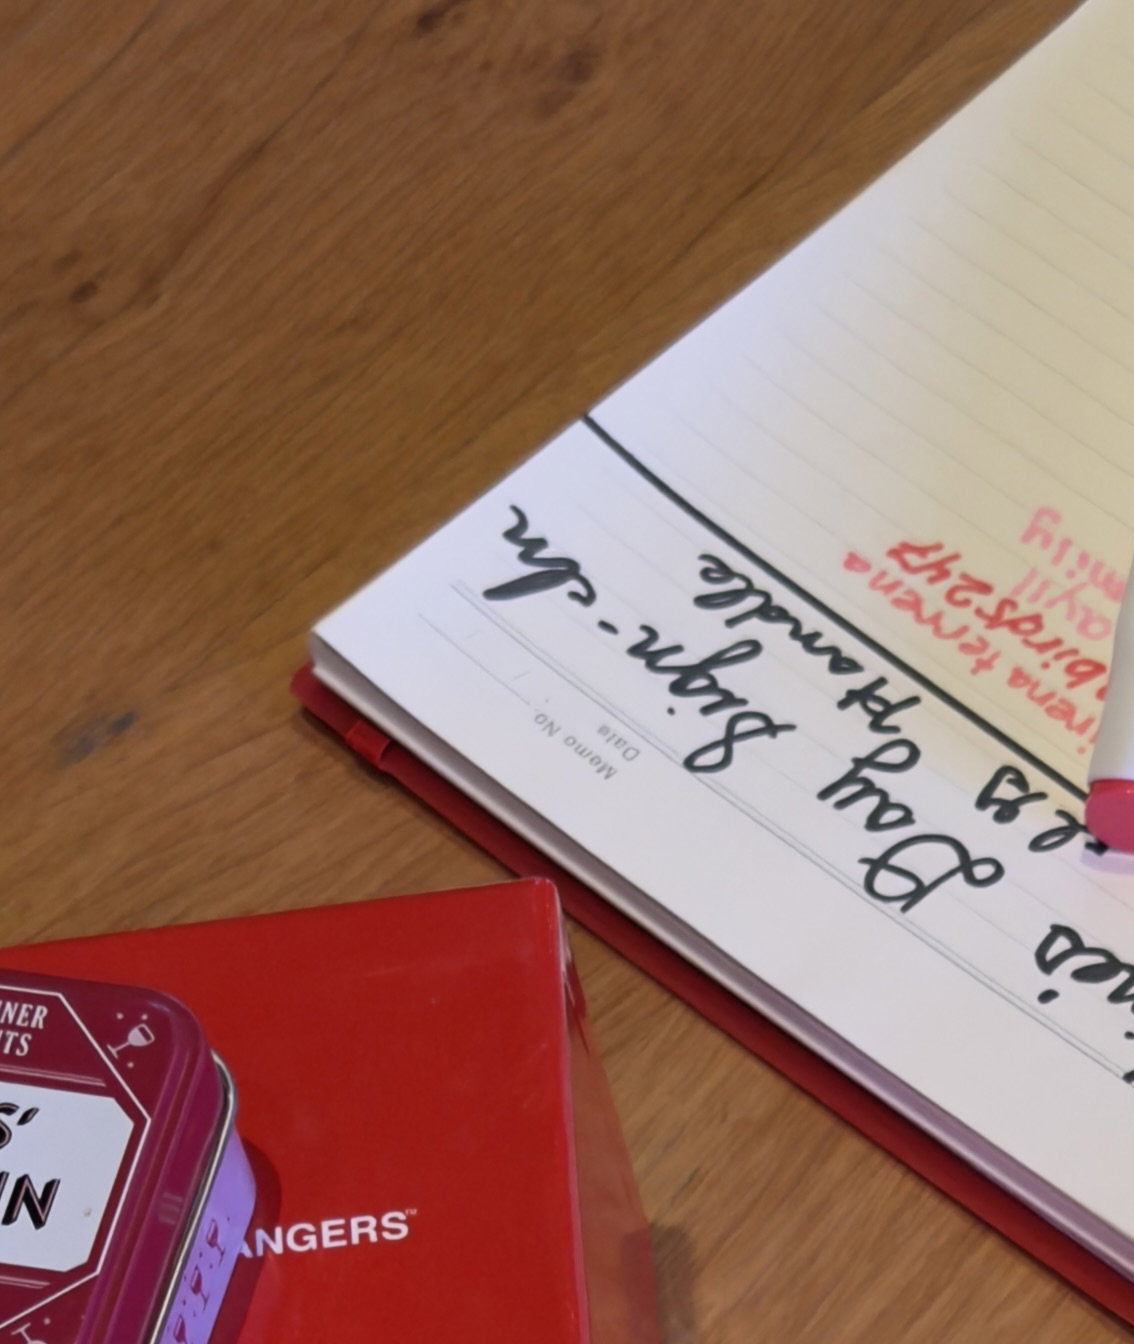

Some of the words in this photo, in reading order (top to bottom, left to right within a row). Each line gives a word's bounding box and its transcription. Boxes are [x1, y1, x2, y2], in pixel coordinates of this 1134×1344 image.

[694, 553, 921, 733] Handle
[886, 541, 1110, 701] birds247
[563, 736, 618, 780] Memo
[597, 724, 640, 761] Date
[817, 739, 1004, 914] Day
[0, 1001, 48, 1029] NER
